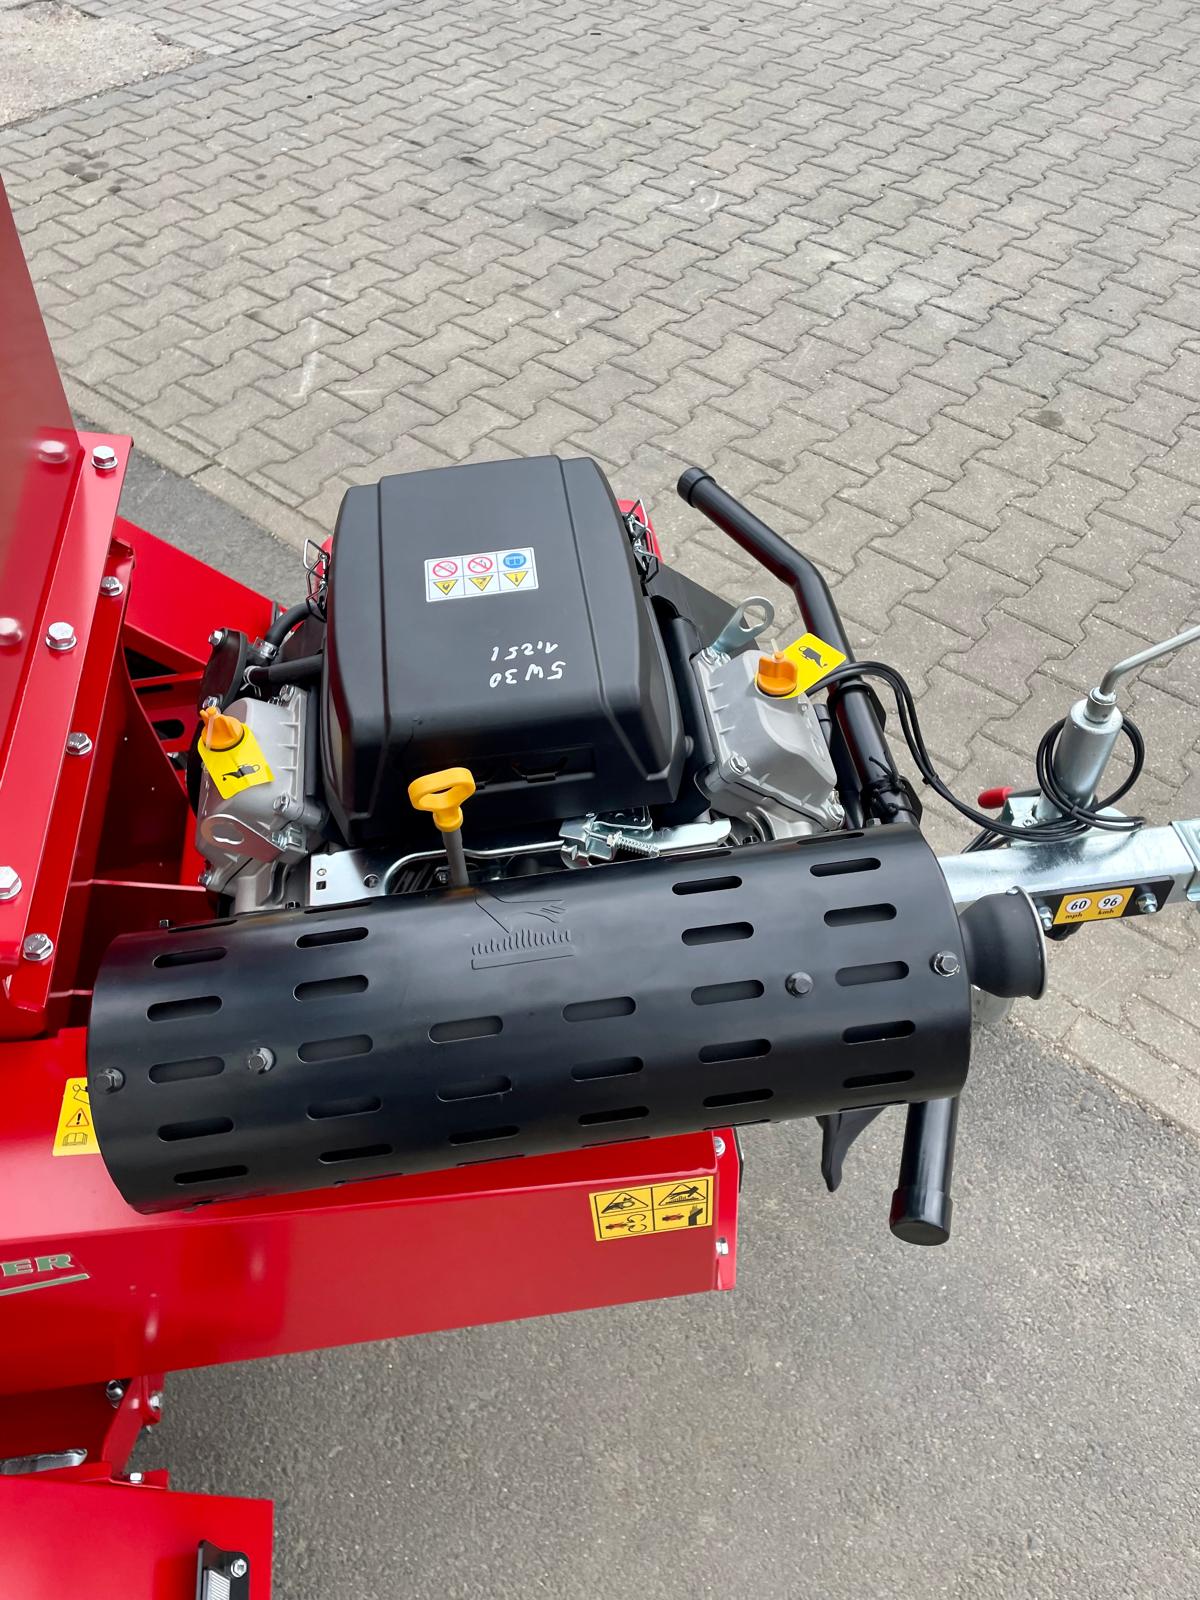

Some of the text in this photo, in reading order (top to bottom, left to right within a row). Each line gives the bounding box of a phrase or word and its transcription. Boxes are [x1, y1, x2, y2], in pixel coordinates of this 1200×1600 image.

[1070, 900, 1088, 911] 60
[1102, 897, 1119, 908] 96
[1065, 912, 1083, 920] mph
